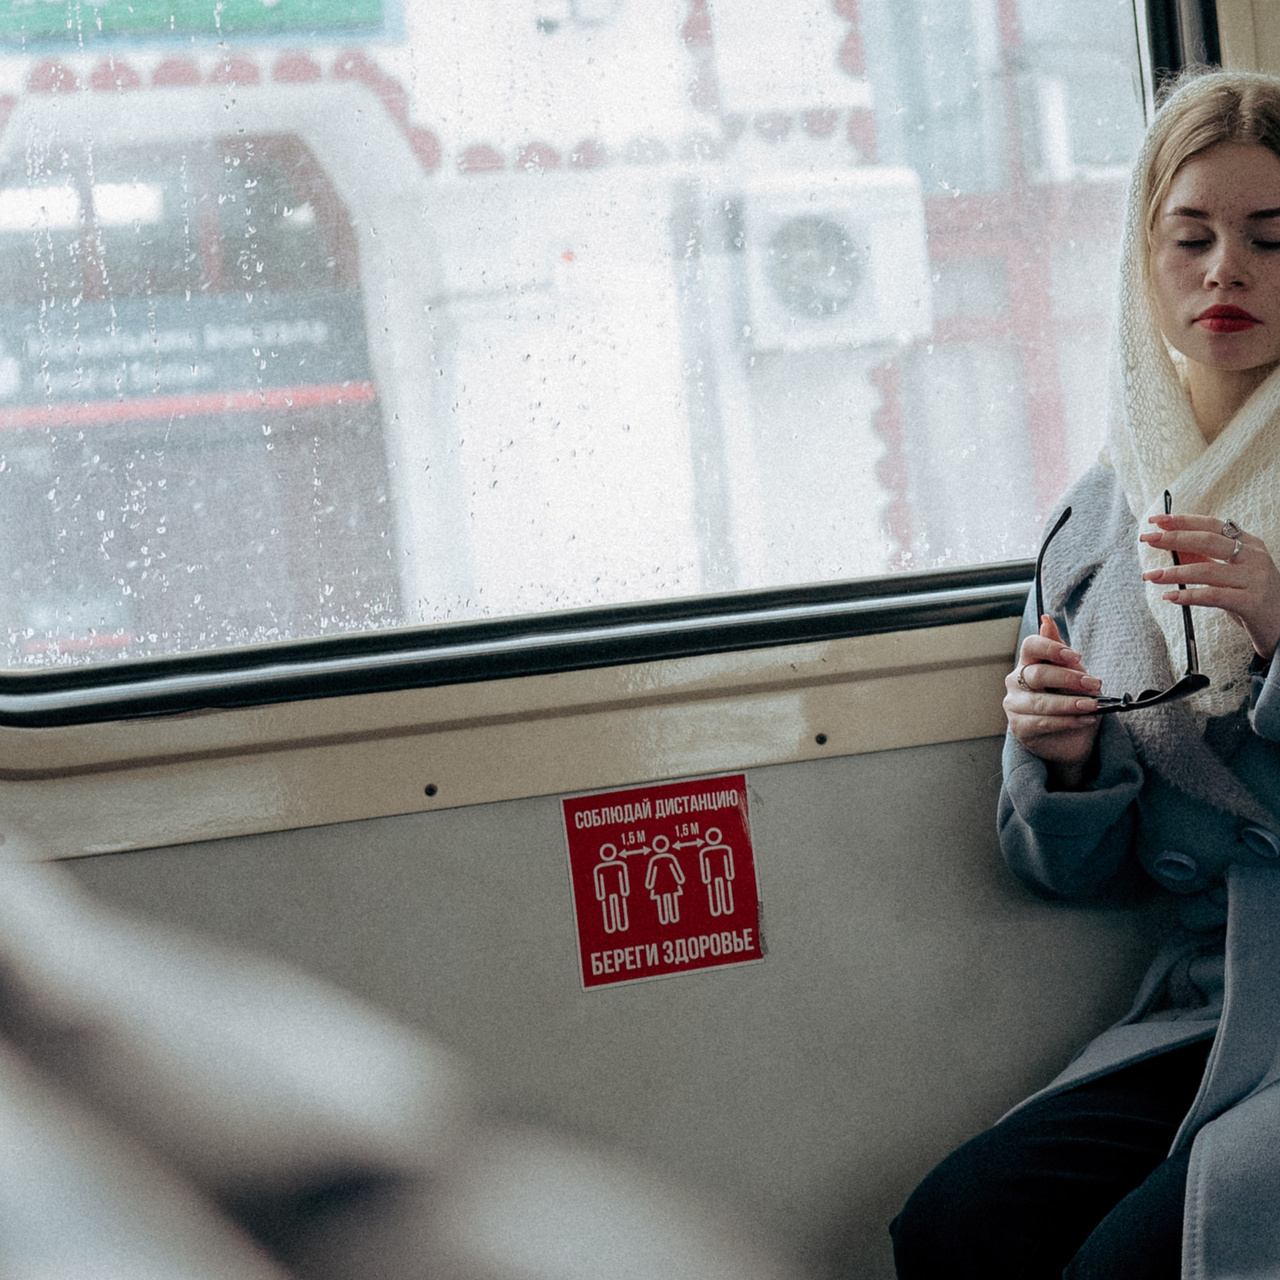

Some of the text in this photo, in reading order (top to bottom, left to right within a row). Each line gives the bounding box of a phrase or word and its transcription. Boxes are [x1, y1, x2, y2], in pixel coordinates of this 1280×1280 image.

[574, 789, 739, 830] СОБЛЮДАЙ ДИСТАНЦИЮ
[620, 830, 647, 846] 1,5 М
[674, 822, 700, 838] 1,5 М
[590, 928, 755, 976] БЕРЕГИ ЗДОРОВЬЕ
